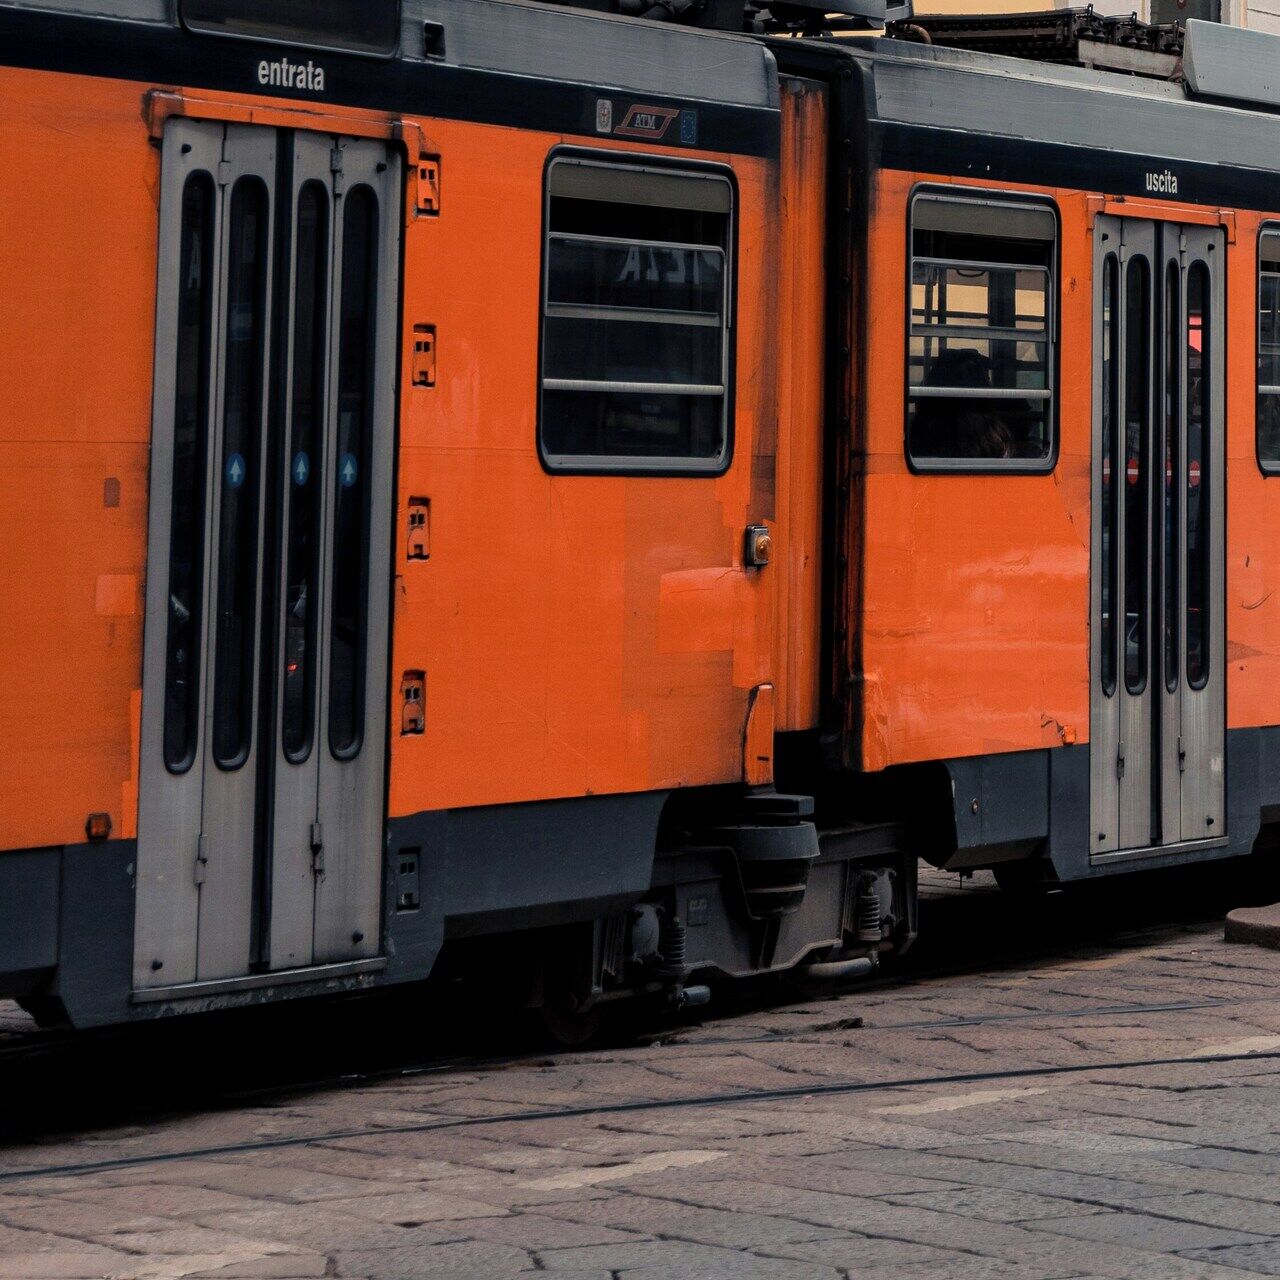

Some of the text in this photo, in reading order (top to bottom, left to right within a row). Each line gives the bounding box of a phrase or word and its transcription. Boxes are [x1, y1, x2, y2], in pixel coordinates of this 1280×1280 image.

[257, 57, 325, 91] entrata
[635, 113, 656, 129] ATM
[1145, 169, 1178, 194] uscita
